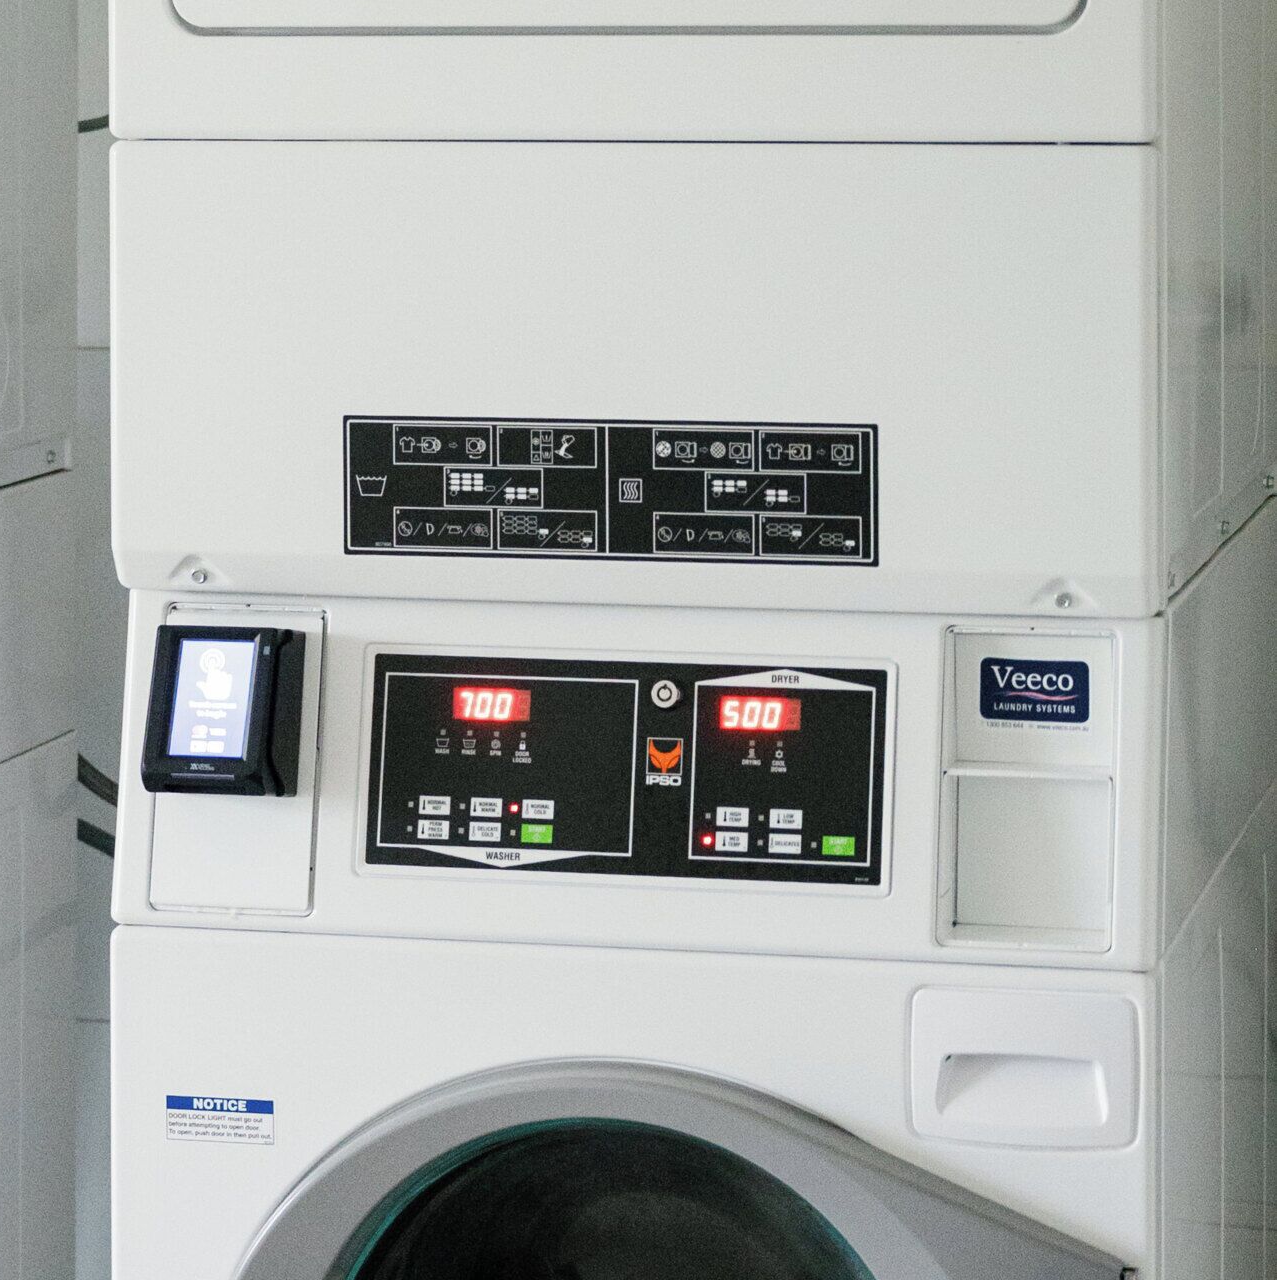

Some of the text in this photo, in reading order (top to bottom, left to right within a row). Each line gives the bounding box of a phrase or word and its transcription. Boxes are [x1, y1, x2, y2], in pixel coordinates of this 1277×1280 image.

[771, 674, 800, 684] DRYER
[991, 665, 1074, 691] Veeco
[460, 691, 513, 719] 700
[993, 702, 1076, 714] LAUNDRY SYSTEMS
[723, 700, 782, 729] 500
[645, 775, 682, 786] IPSO
[485, 851, 521, 861] WASHER
[193, 1098, 247, 1112] NOTICE
